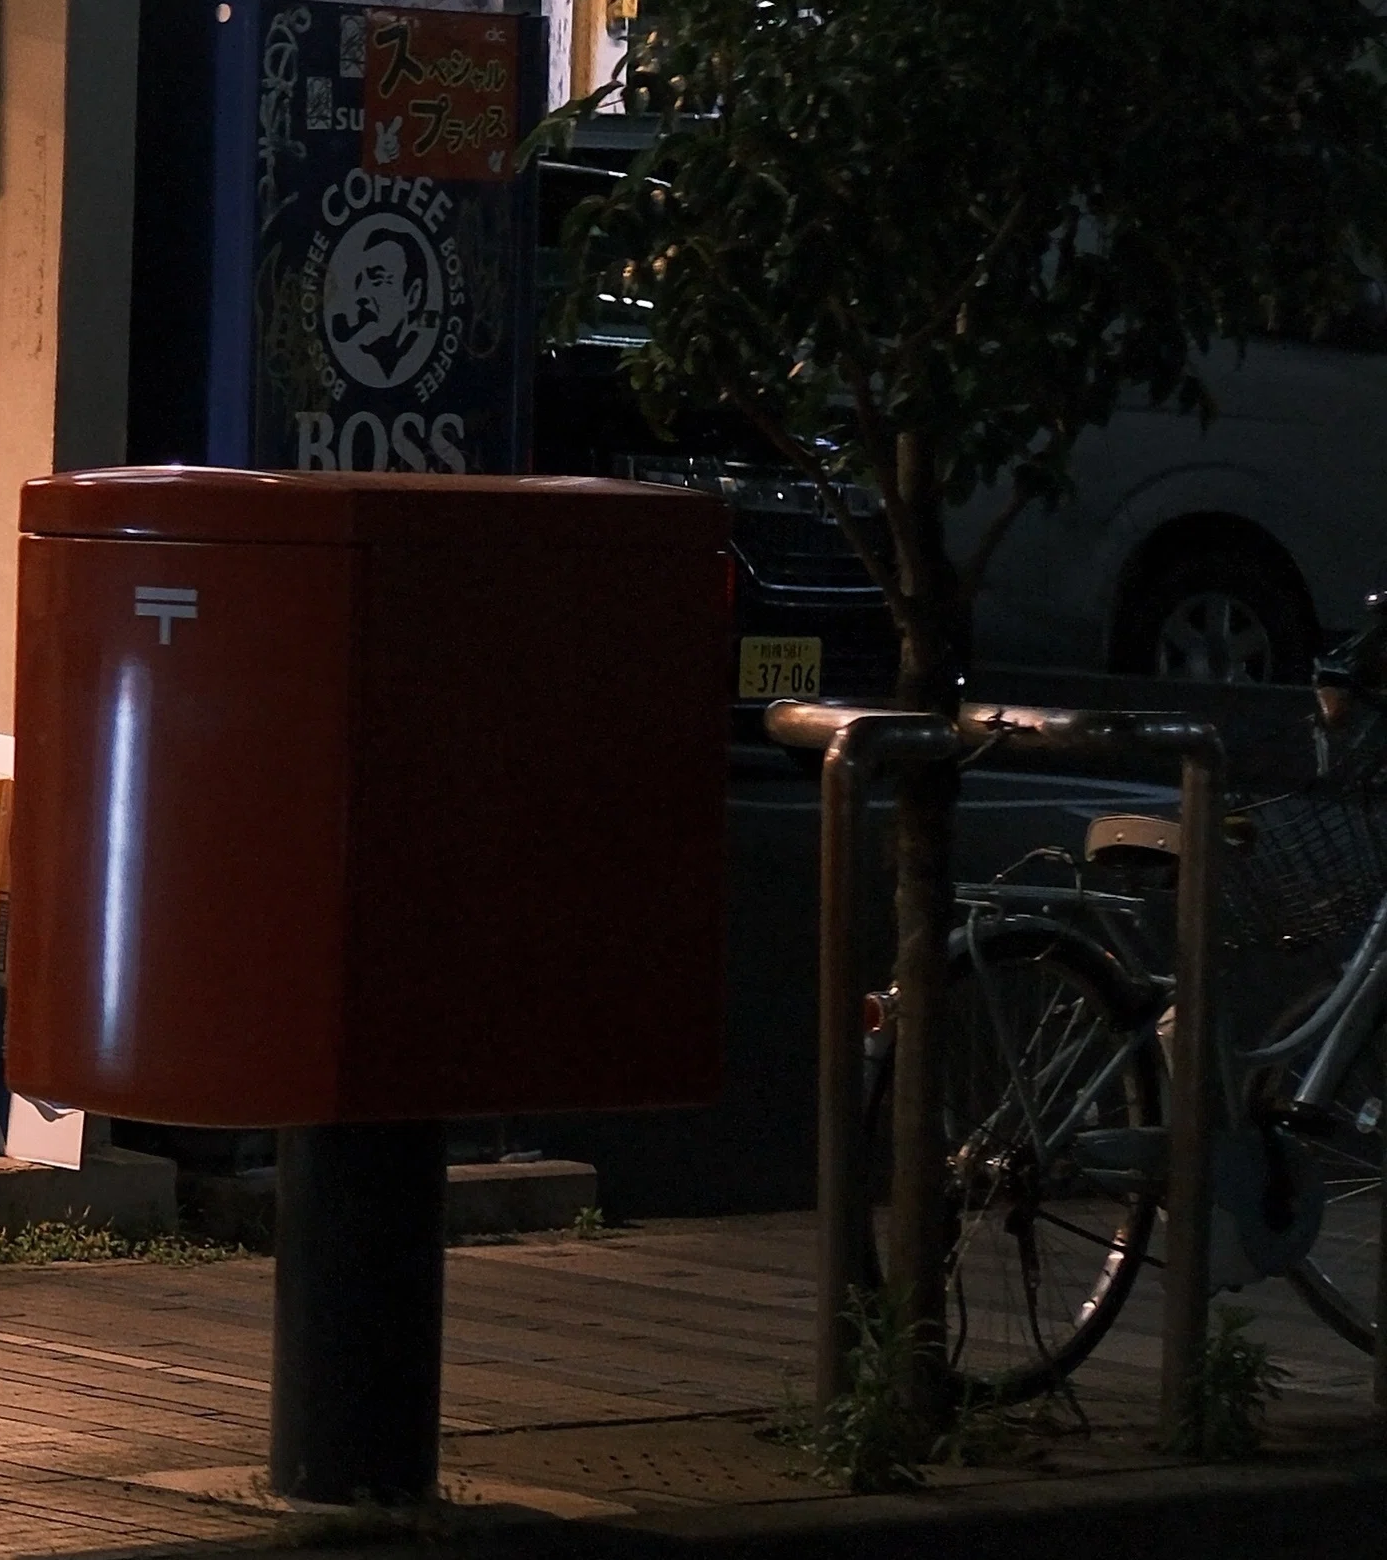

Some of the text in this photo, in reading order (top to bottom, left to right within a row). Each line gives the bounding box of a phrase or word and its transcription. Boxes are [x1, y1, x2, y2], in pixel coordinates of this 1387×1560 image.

[373, 20, 507, 100] スペシャル
[408, 93, 508, 157] プライス
[300, 230, 330, 333] COFFEE
[414, 236, 466, 405] BOSS COFFEE
[294, 410, 467, 475] BOSS
